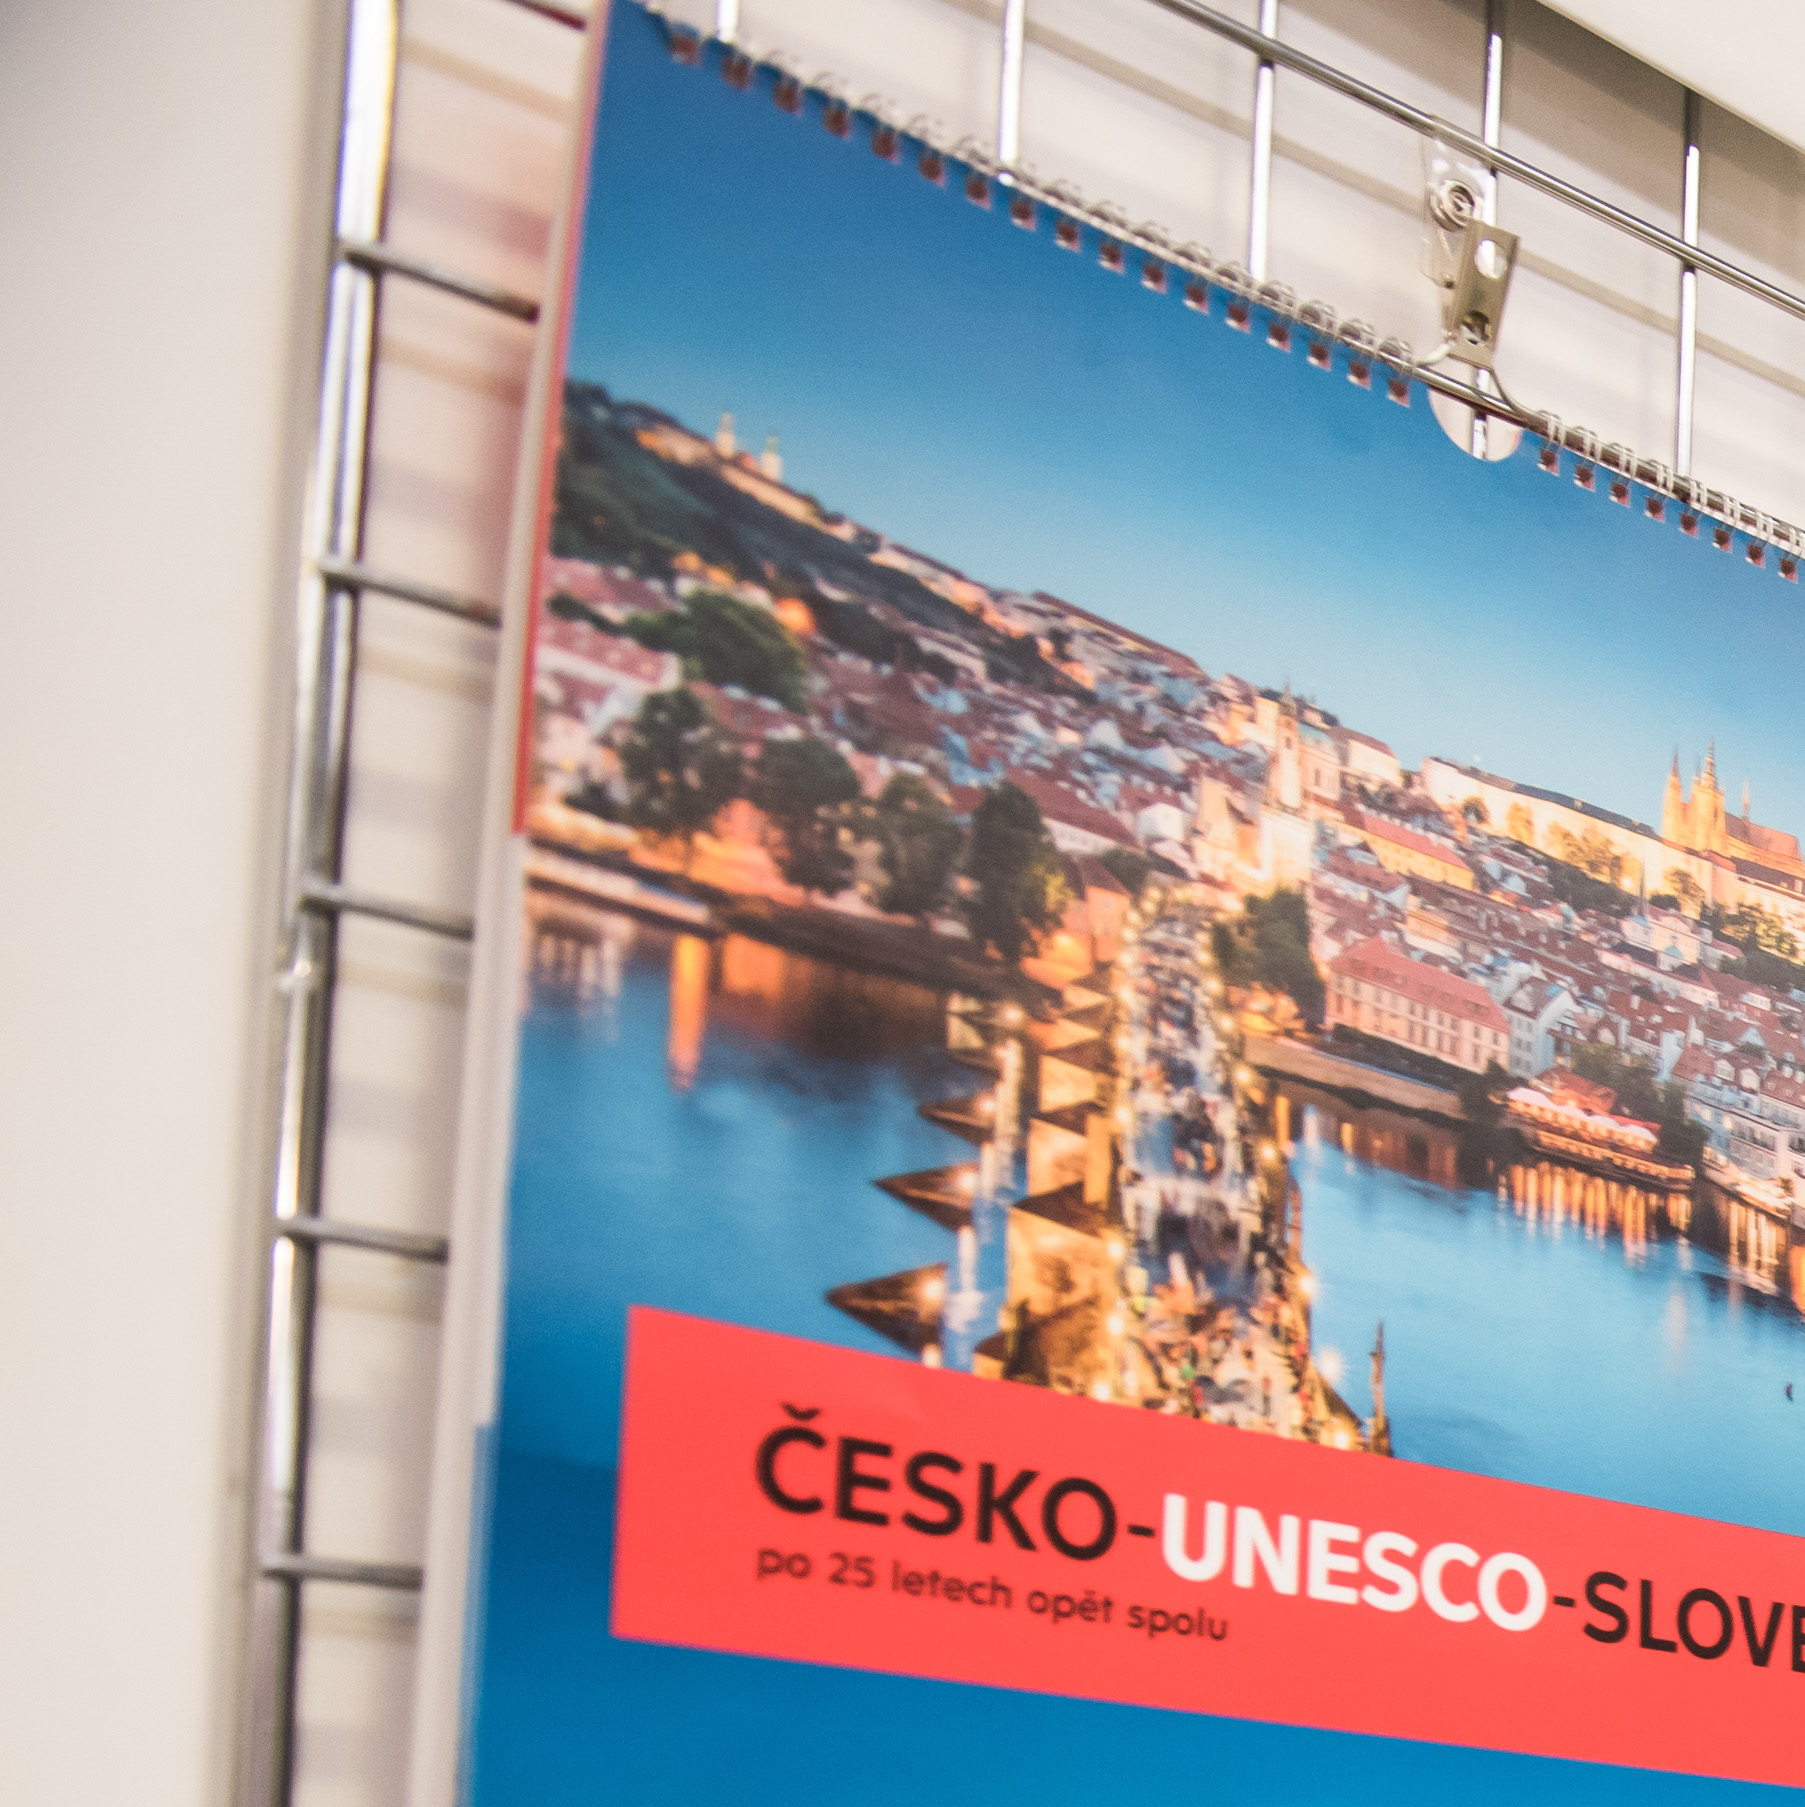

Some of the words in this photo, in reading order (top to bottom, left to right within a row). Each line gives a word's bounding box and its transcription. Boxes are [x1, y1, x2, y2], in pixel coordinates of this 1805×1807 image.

[756, 1547, 812, 1581] po
[828, 1551, 876, 1589] 25
[891, 1560, 1012, 1609] letech
[1026, 1590, 1113, 1625] opět
[1127, 1604, 1229, 1641] spolu
